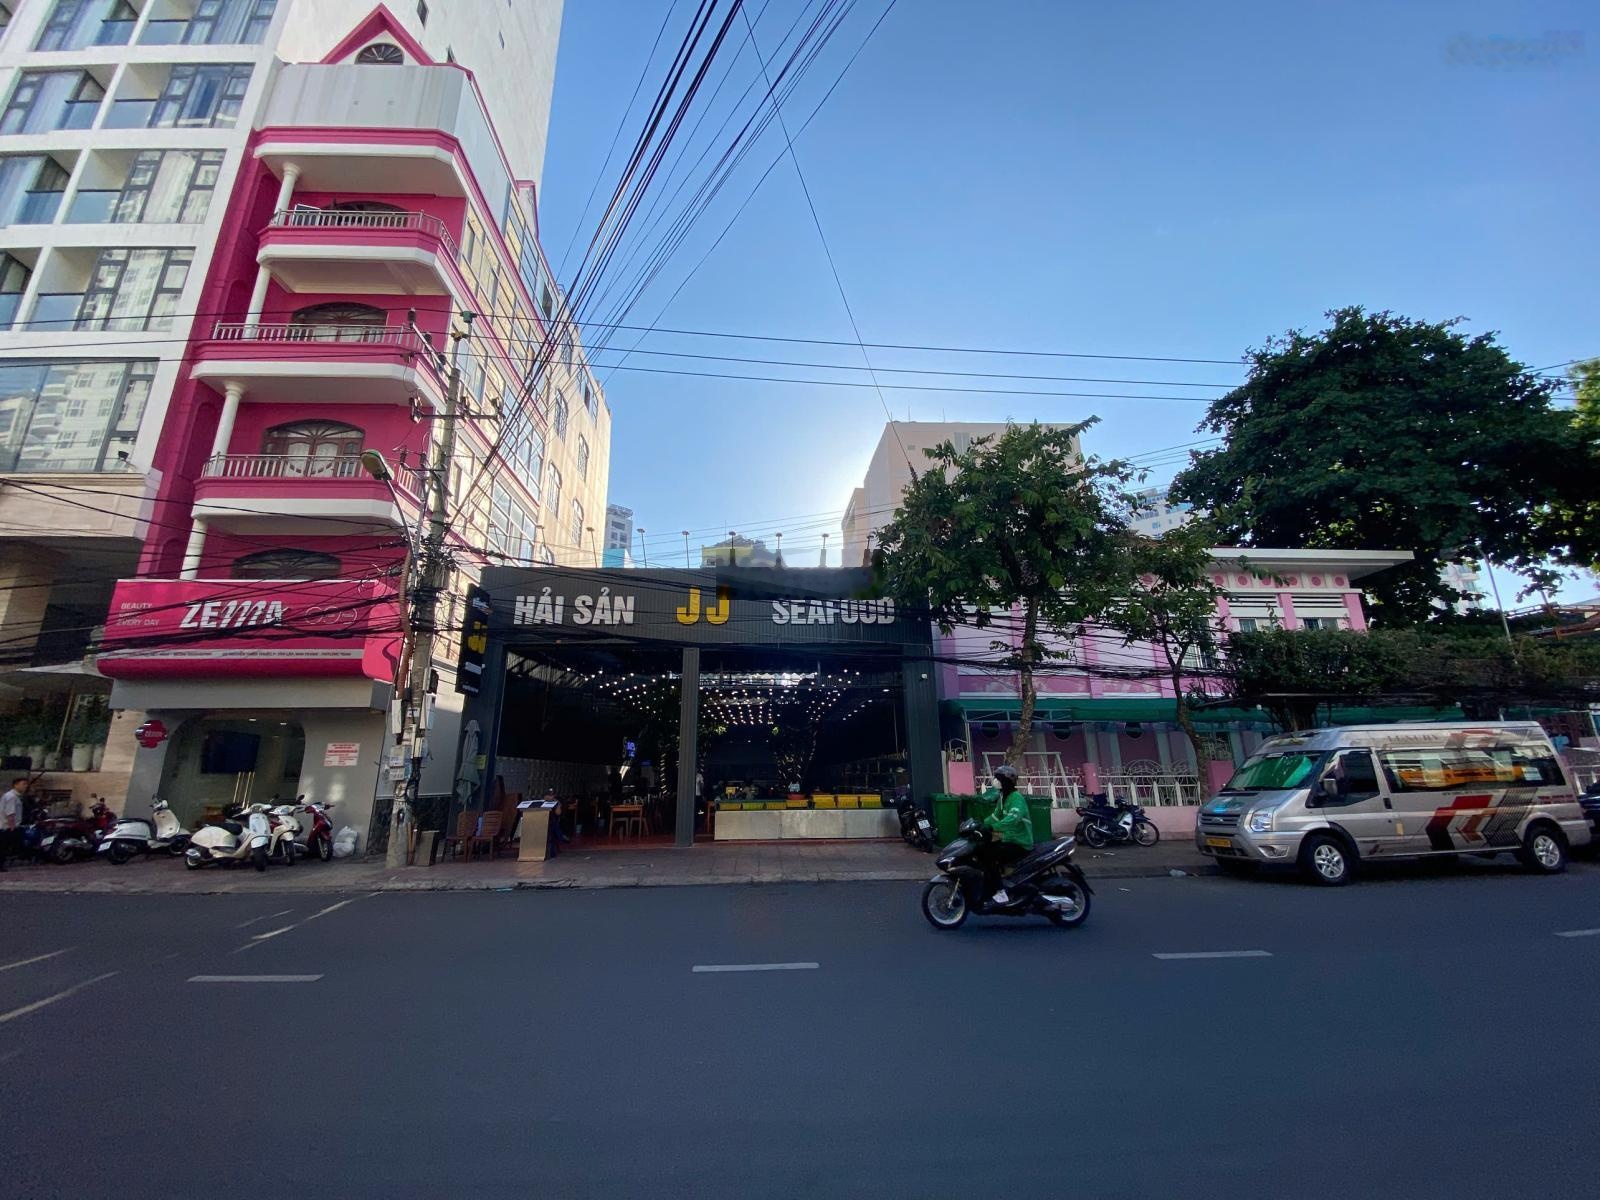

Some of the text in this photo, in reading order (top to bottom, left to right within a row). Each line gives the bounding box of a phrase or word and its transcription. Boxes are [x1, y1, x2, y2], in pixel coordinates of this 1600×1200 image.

[120, 602, 153, 610] BEAUTY
[513, 586, 565, 625] HẢI
[572, 586, 635, 625] SẢN
[676, 586, 730, 625] JJ
[771, 598, 896, 625] SEAFOOD
[143, 618, 161, 626] DAY
